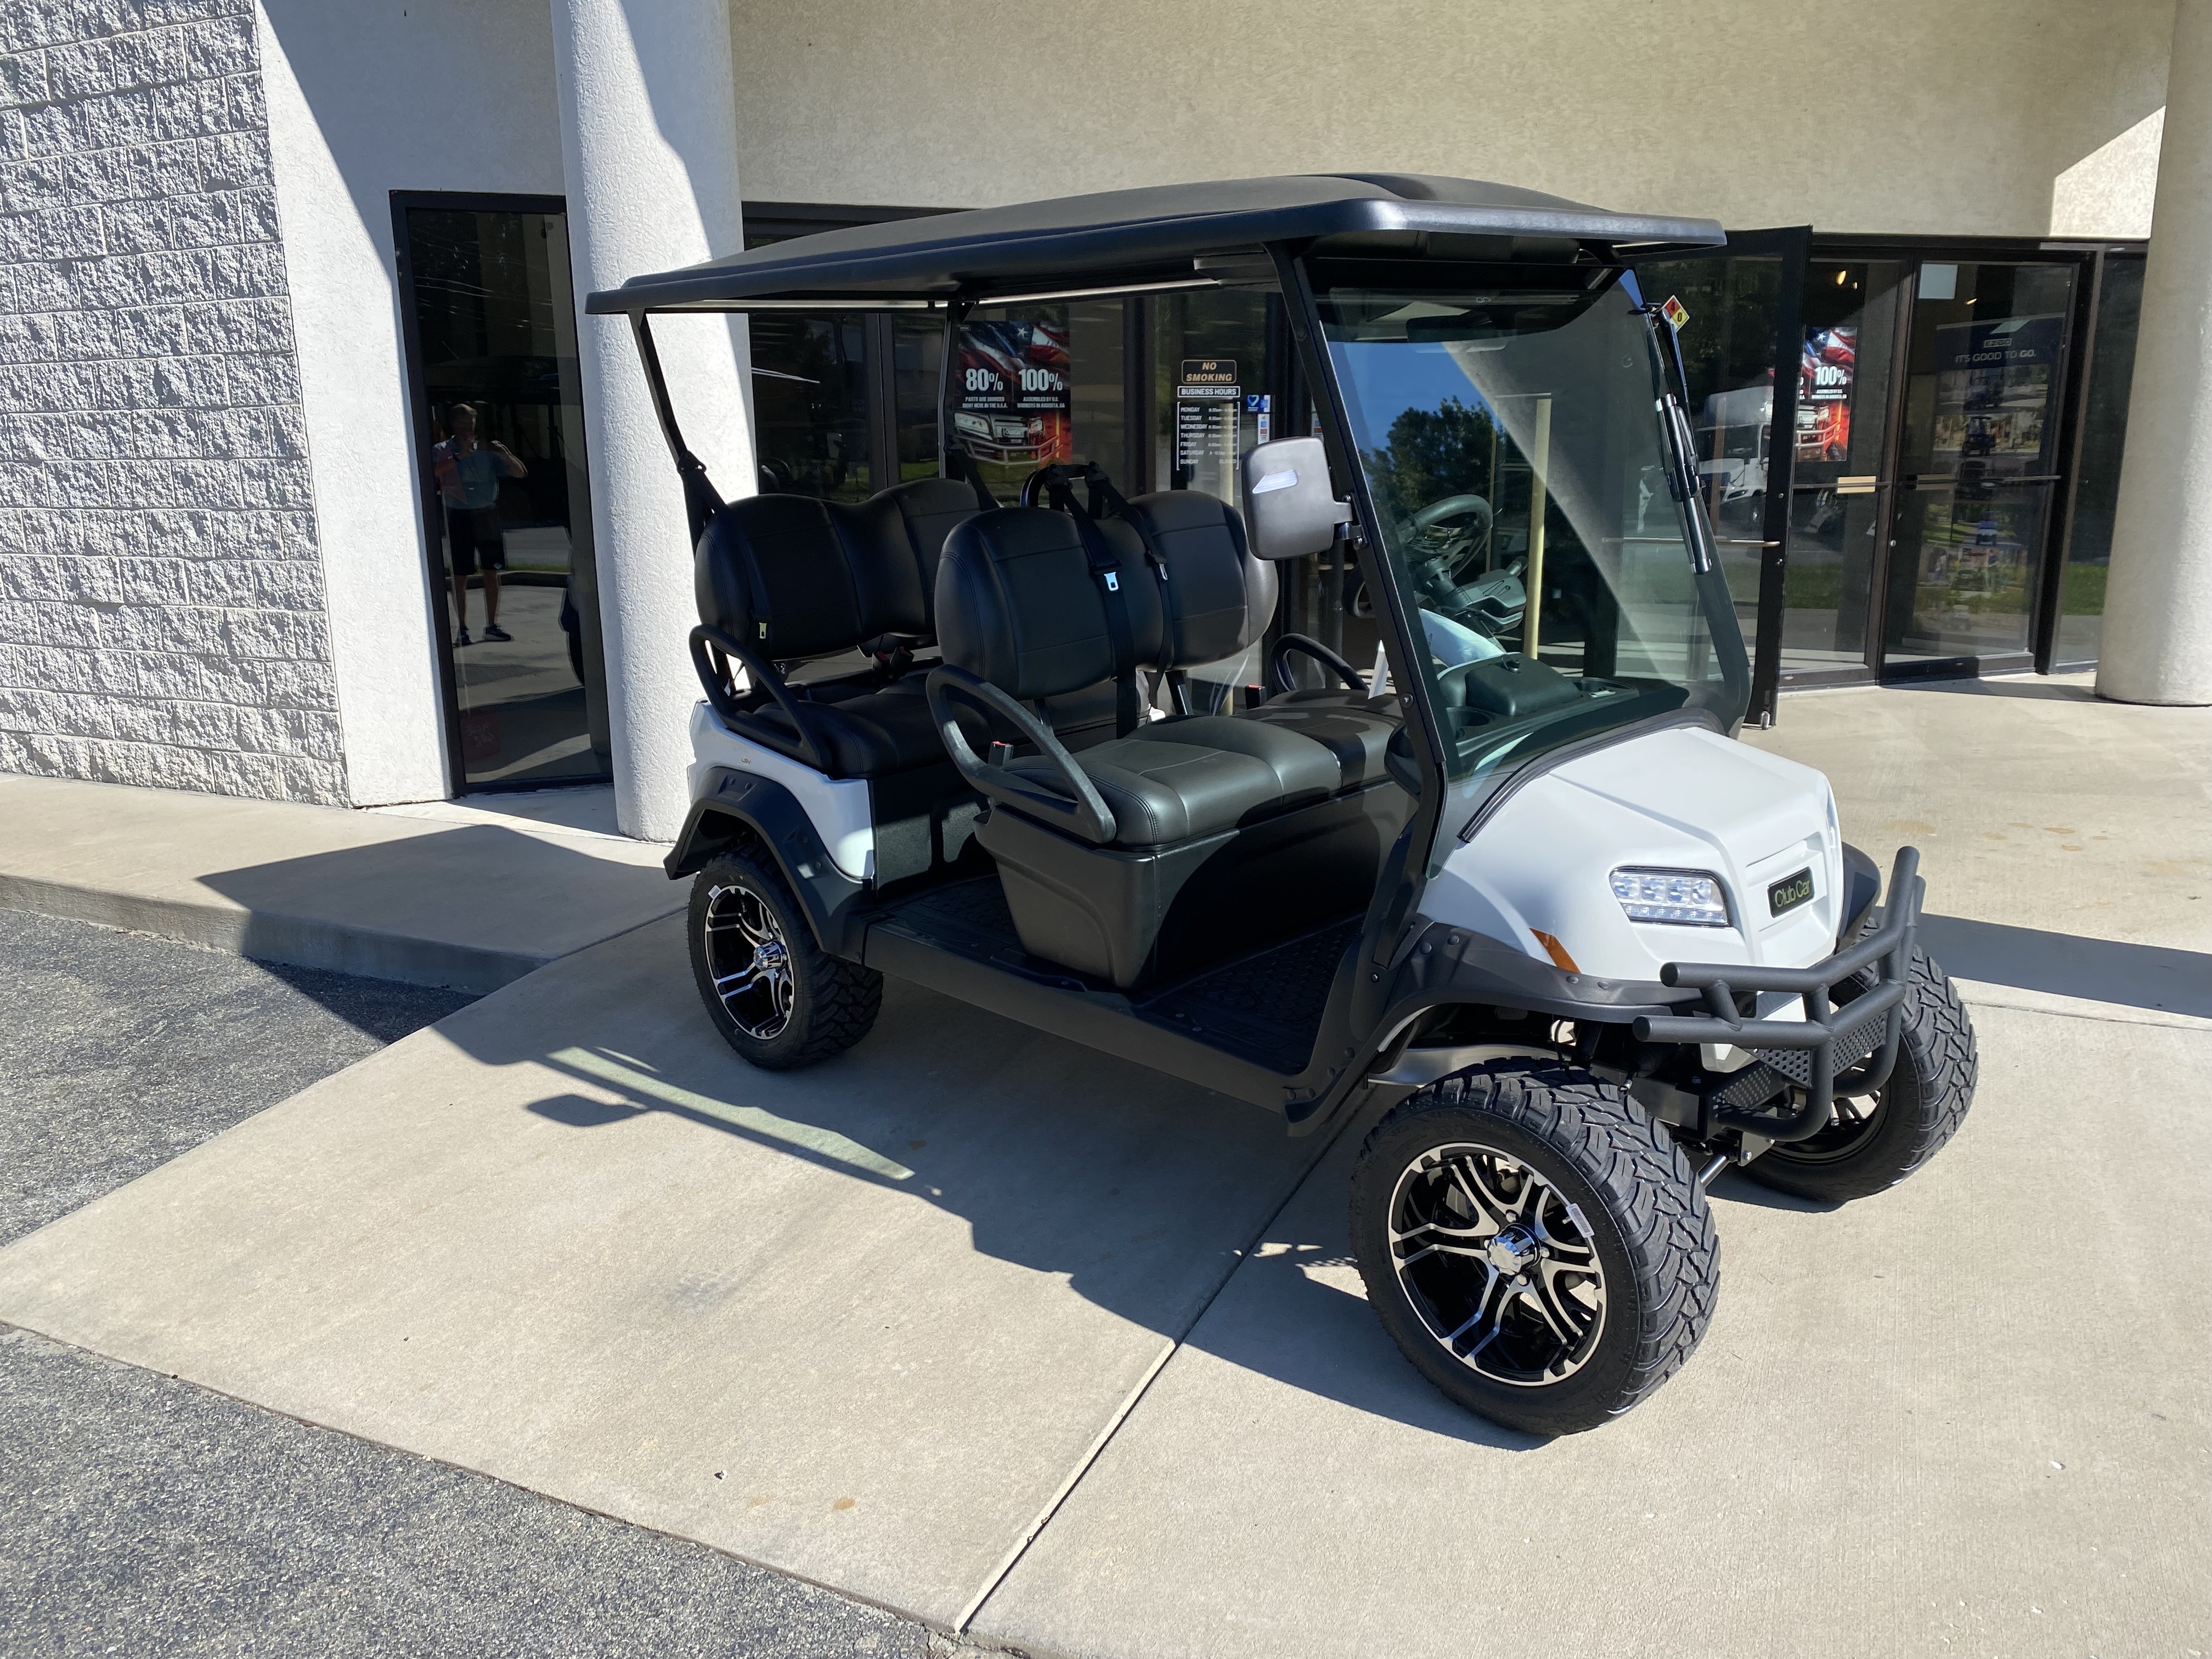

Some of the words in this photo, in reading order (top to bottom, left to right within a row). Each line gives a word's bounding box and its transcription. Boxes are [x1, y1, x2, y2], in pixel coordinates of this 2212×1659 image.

[1671, 302, 1675, 311] 4
[1678, 313, 1682, 321] 0
[1973, 352, 2002, 361] GOOD
[966, 368, 1003, 391] 80%
[1018, 369, 1063, 391] 100%
[1815, 366, 1847, 385] 100%
[1775, 885, 1796, 907] Club
[1795, 880, 1810, 898] Car
